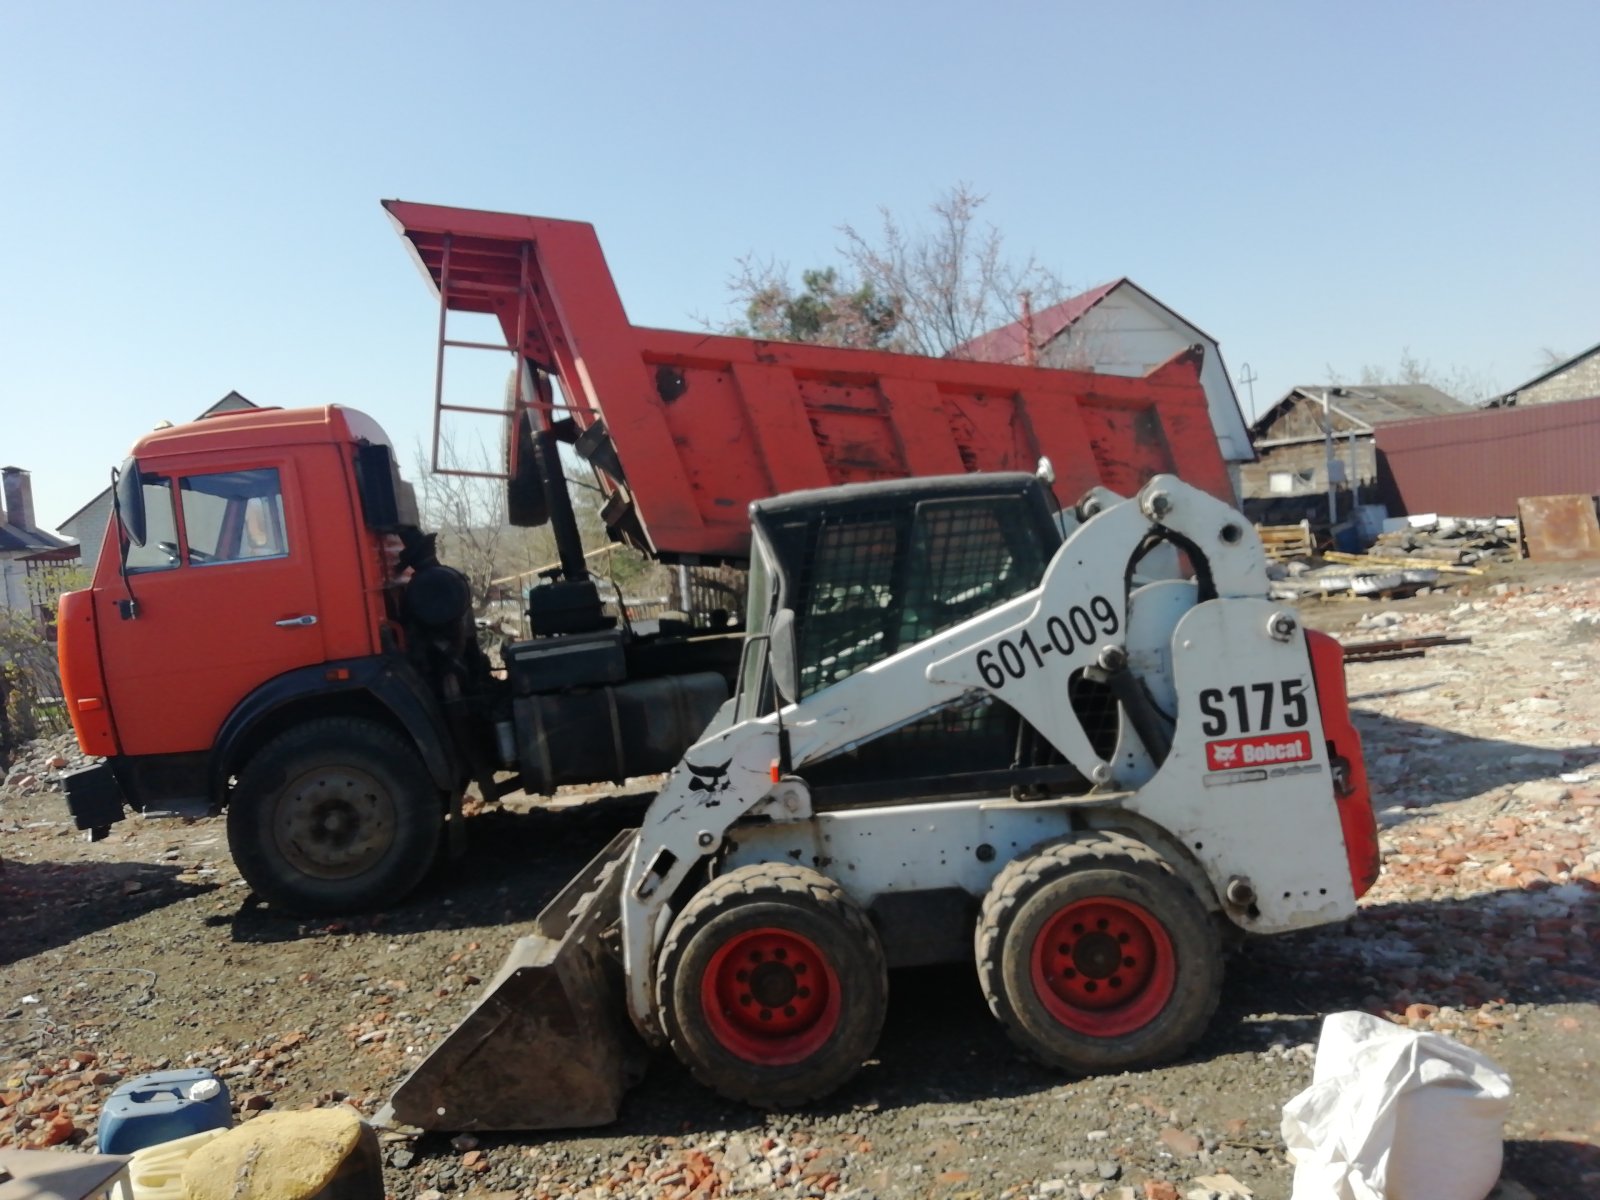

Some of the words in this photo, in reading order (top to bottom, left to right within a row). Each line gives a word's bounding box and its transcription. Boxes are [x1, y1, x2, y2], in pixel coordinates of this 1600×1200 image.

[976, 595, 1119, 689] 601-009
[1200, 678, 1308, 737] S175
[1242, 739, 1304, 764] Bobcat
